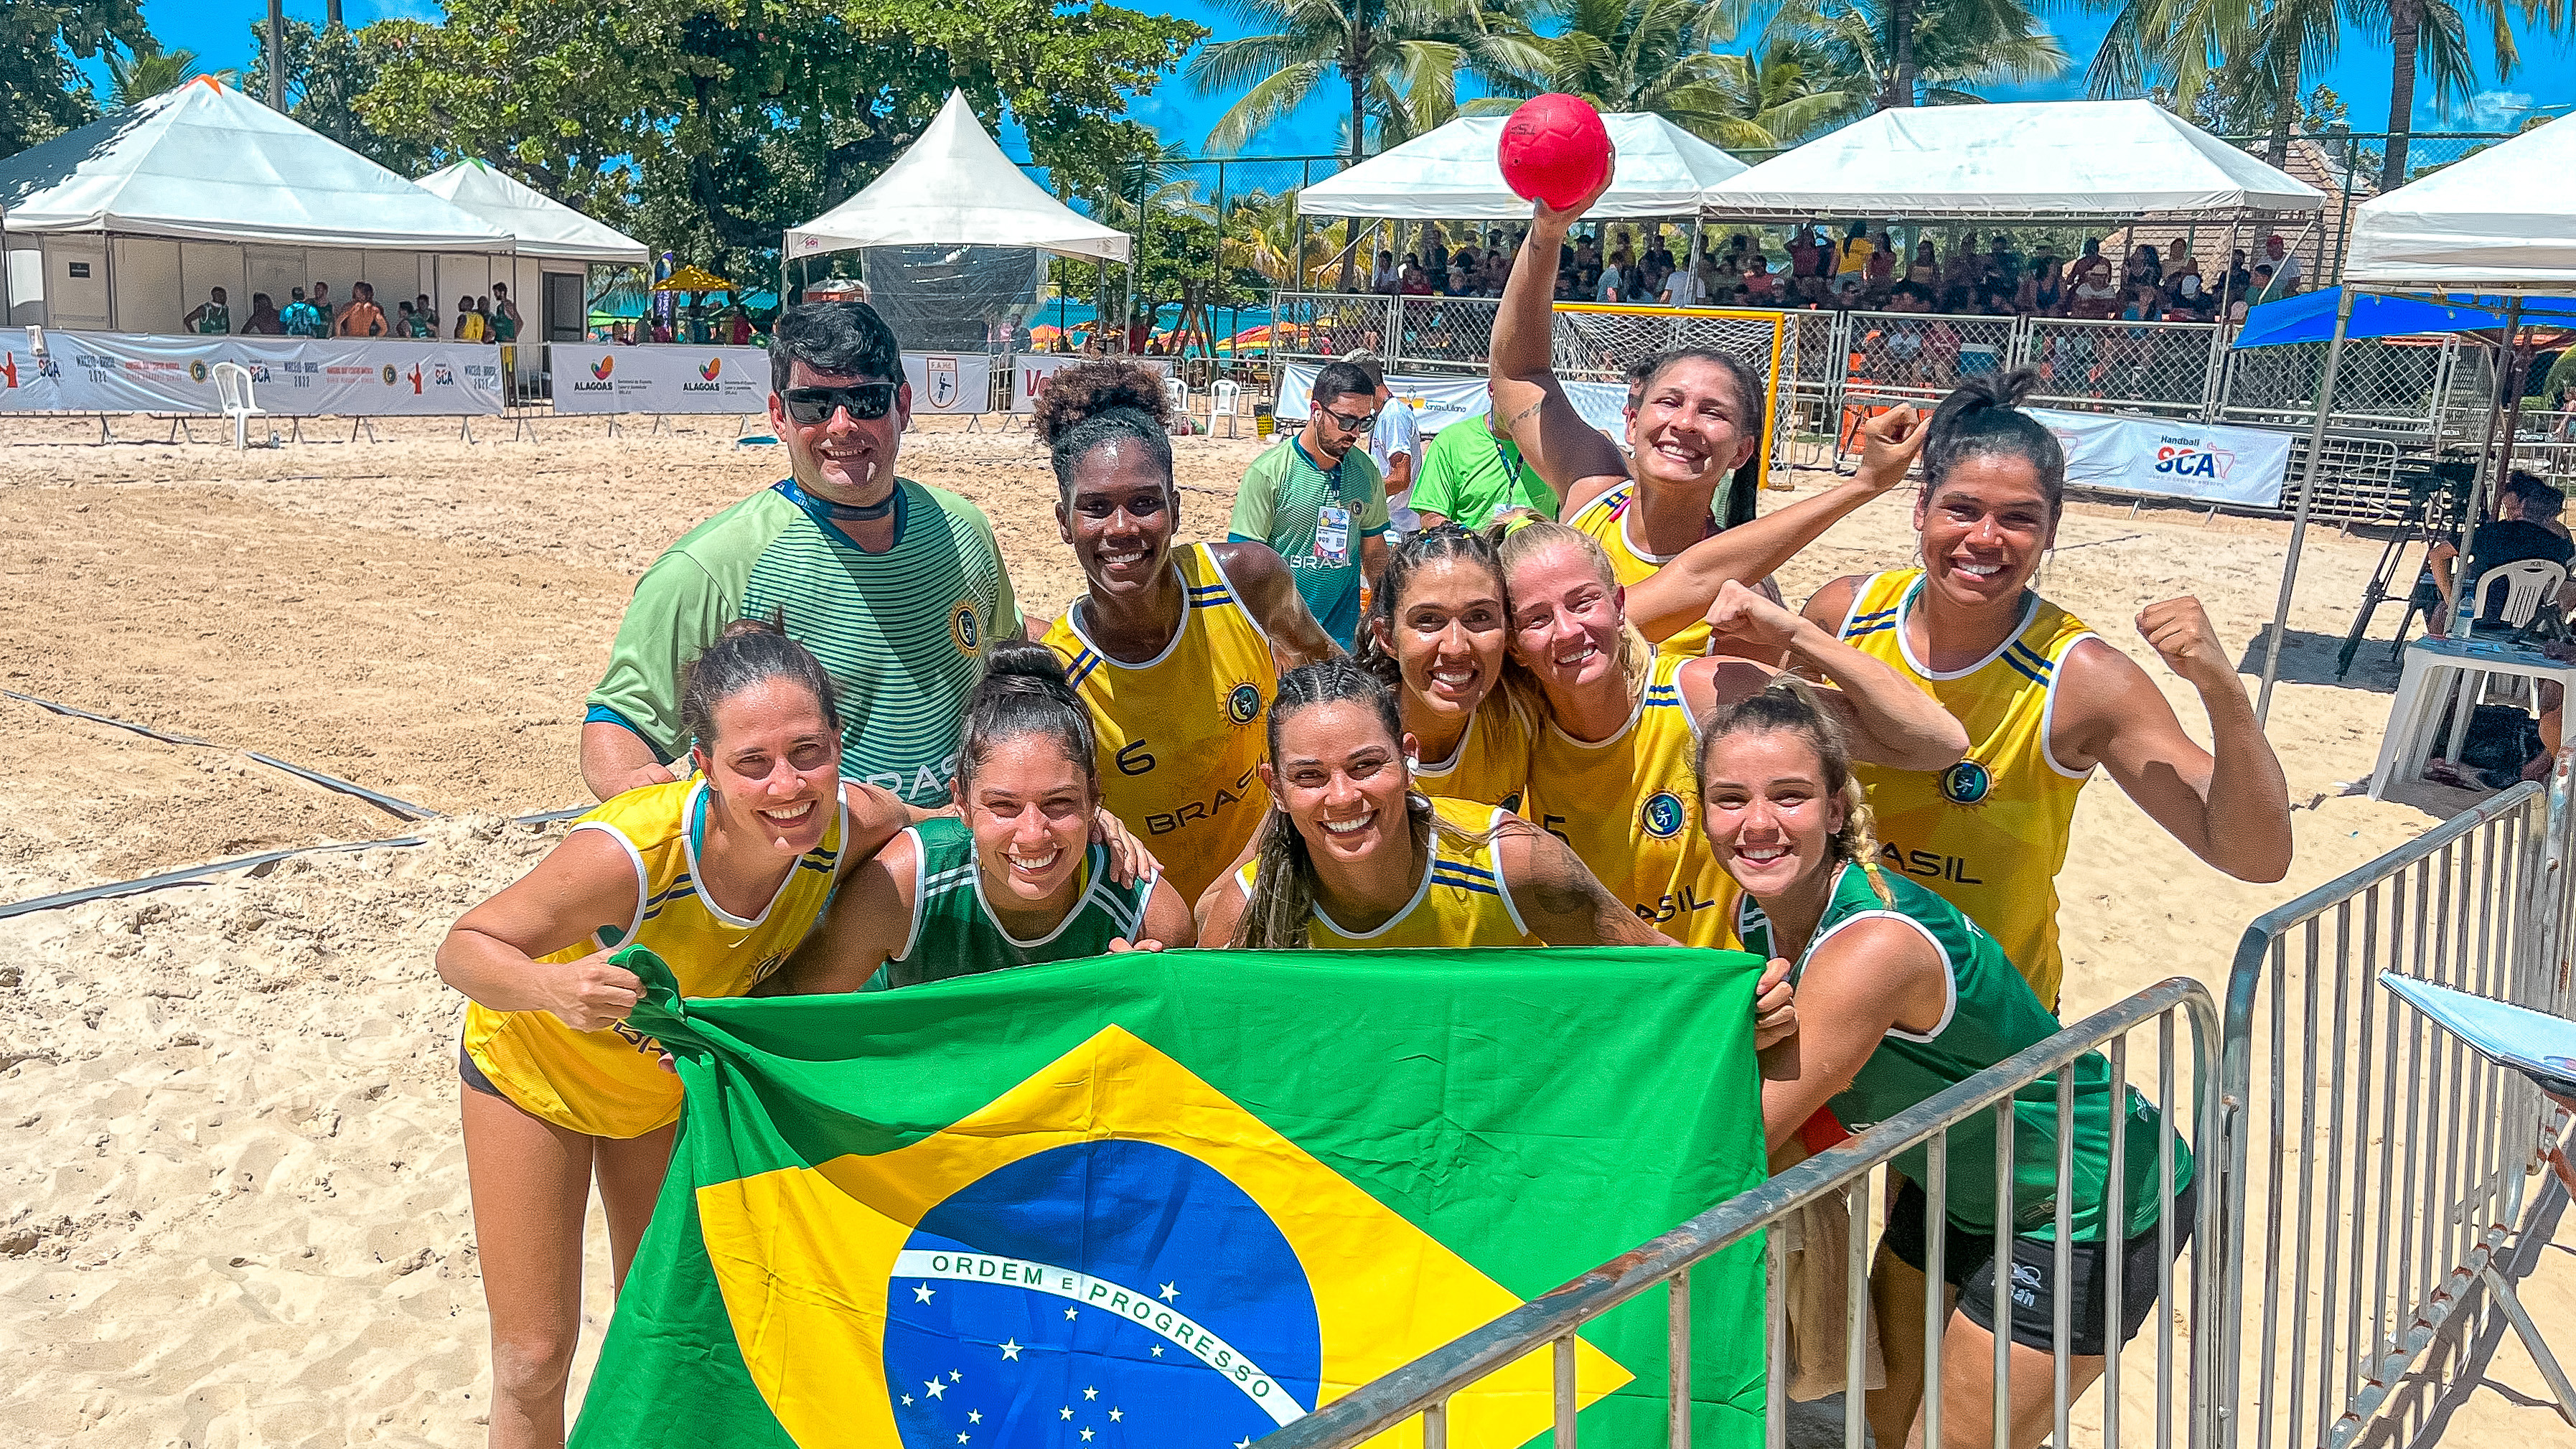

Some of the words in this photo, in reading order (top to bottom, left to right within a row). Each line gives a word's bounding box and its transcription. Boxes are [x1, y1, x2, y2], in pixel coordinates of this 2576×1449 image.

[574, 382, 612, 391] ALAGOAS
[683, 383, 720, 392] ALAGOAS
[2160, 434, 2200, 446] Handball
[2155, 446, 2215, 479] SCA
[1115, 738, 1156, 776] 6
[932, 1255, 1042, 1286] ORDEM
[1062, 1277, 1074, 1290] E
[1089, 1282, 1270, 1398] PROGRESSO
